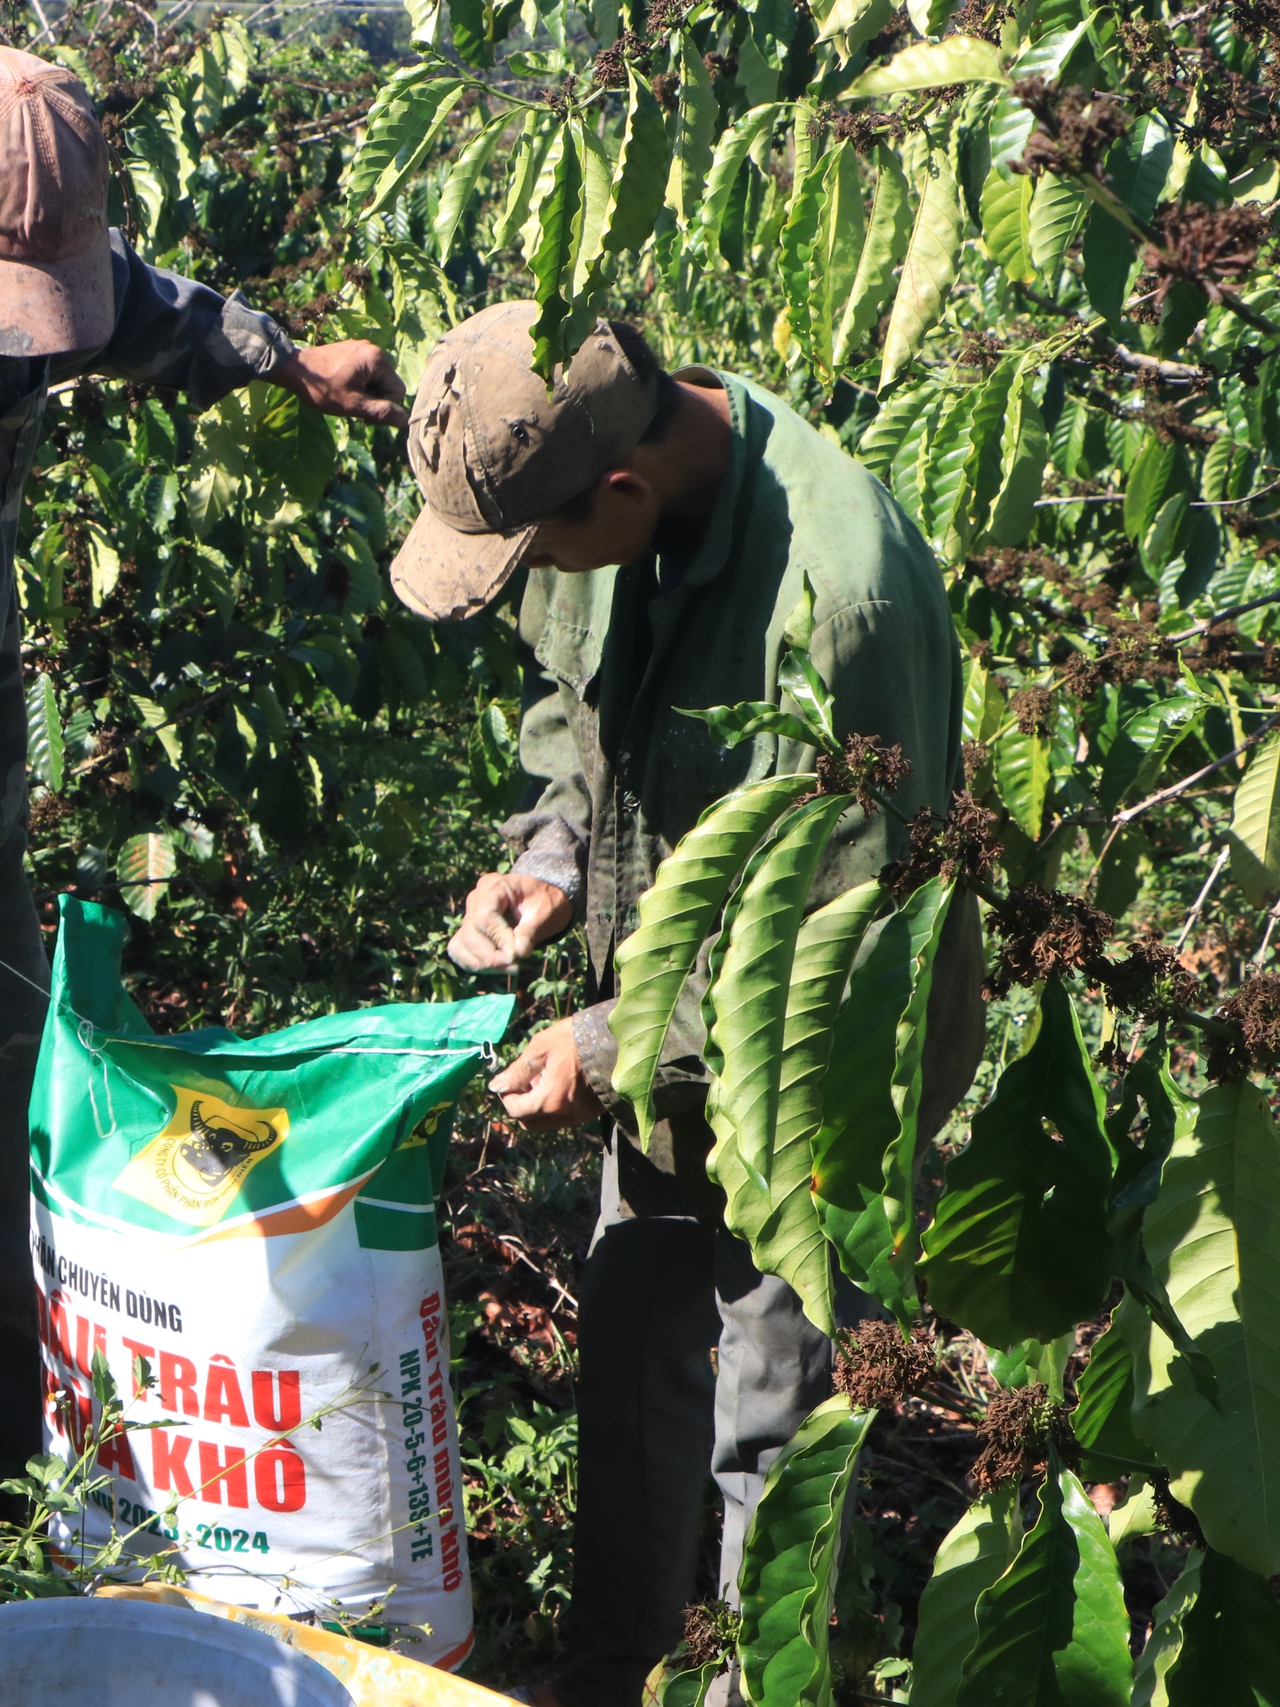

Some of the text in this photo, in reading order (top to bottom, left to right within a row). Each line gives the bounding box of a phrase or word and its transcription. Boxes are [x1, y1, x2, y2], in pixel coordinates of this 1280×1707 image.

[58, 1255, 121, 1313] CHUYÊN
[126, 1289, 183, 1334] DÙNG
[122, 1336, 302, 1432] TRÂU
[399, 1348, 422, 1398] NPK
[152, 1427, 306, 1513] KHÔ
[196, 1523, 270, 1554] 2024
